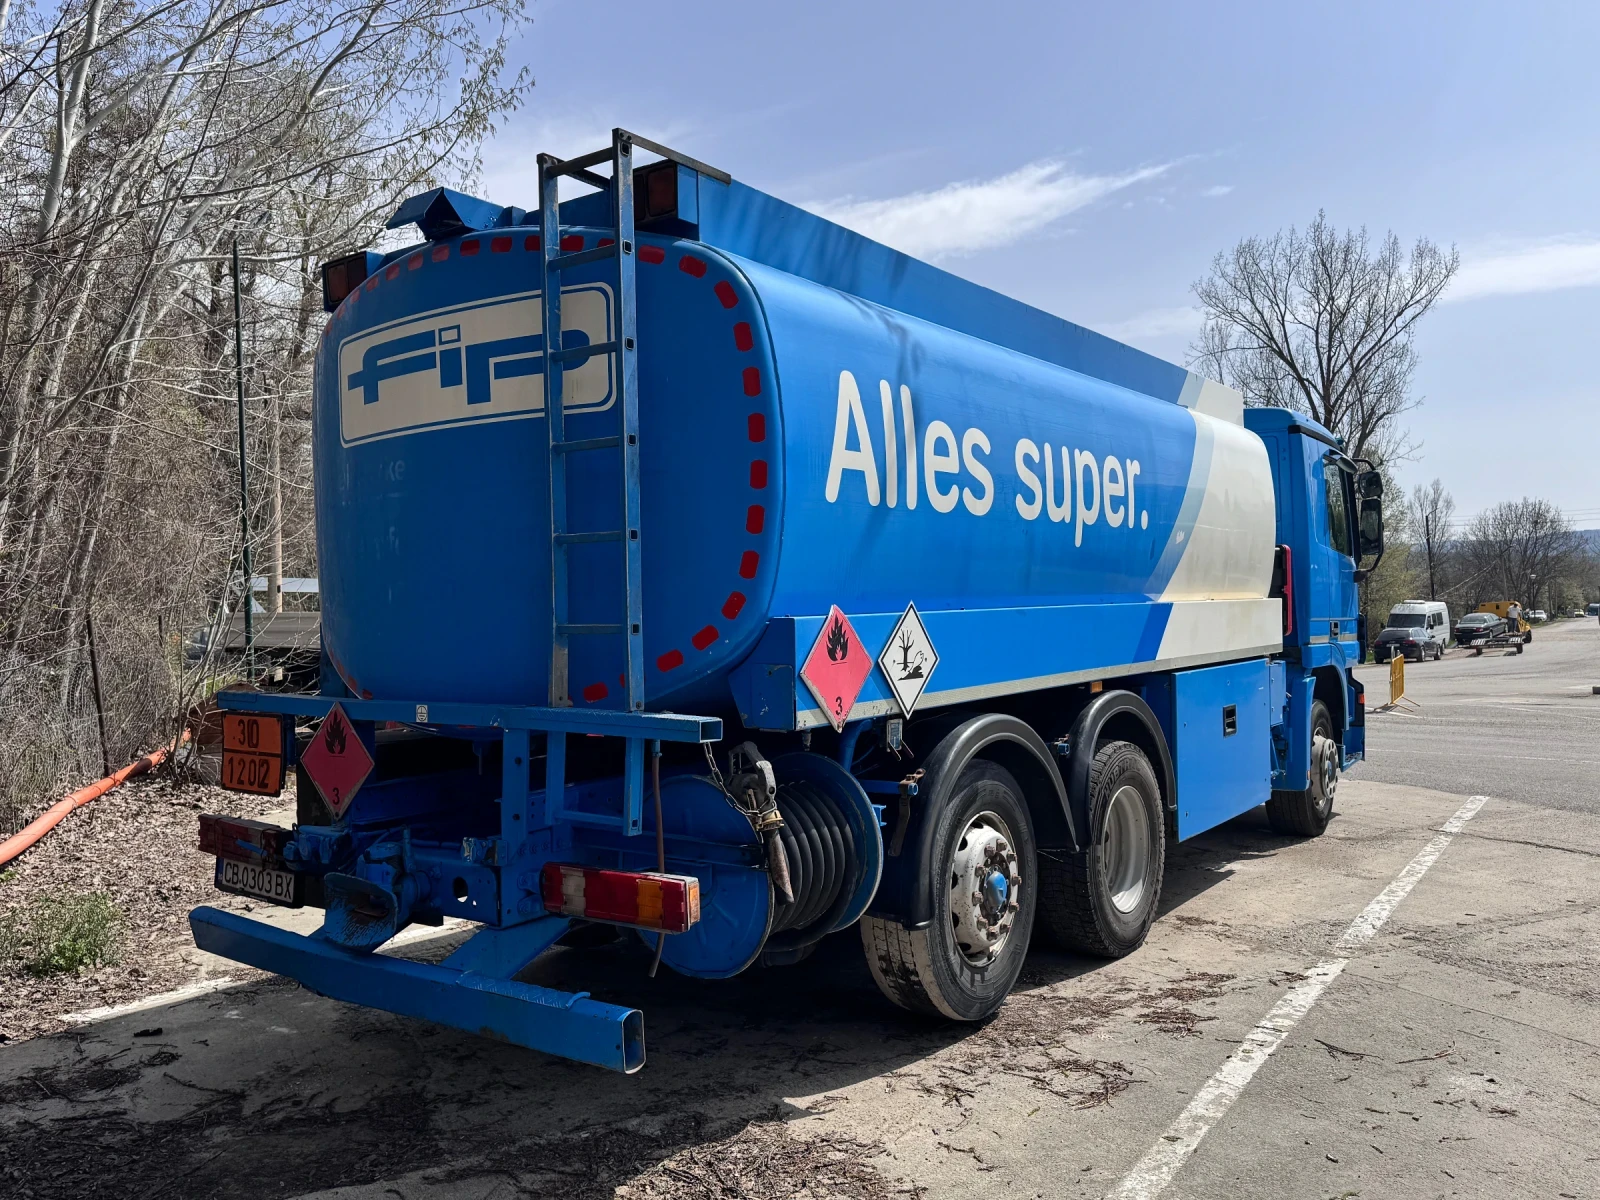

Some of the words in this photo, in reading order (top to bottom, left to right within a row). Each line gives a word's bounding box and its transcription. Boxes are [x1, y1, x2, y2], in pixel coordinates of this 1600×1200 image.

[825, 370, 995, 516] Alles
[1014, 438, 1149, 548] super.
[835, 696, 843, 716] 3
[237, 718, 260, 748] 30
[228, 757, 270, 789] 1202
[332, 787, 340, 806] 3
